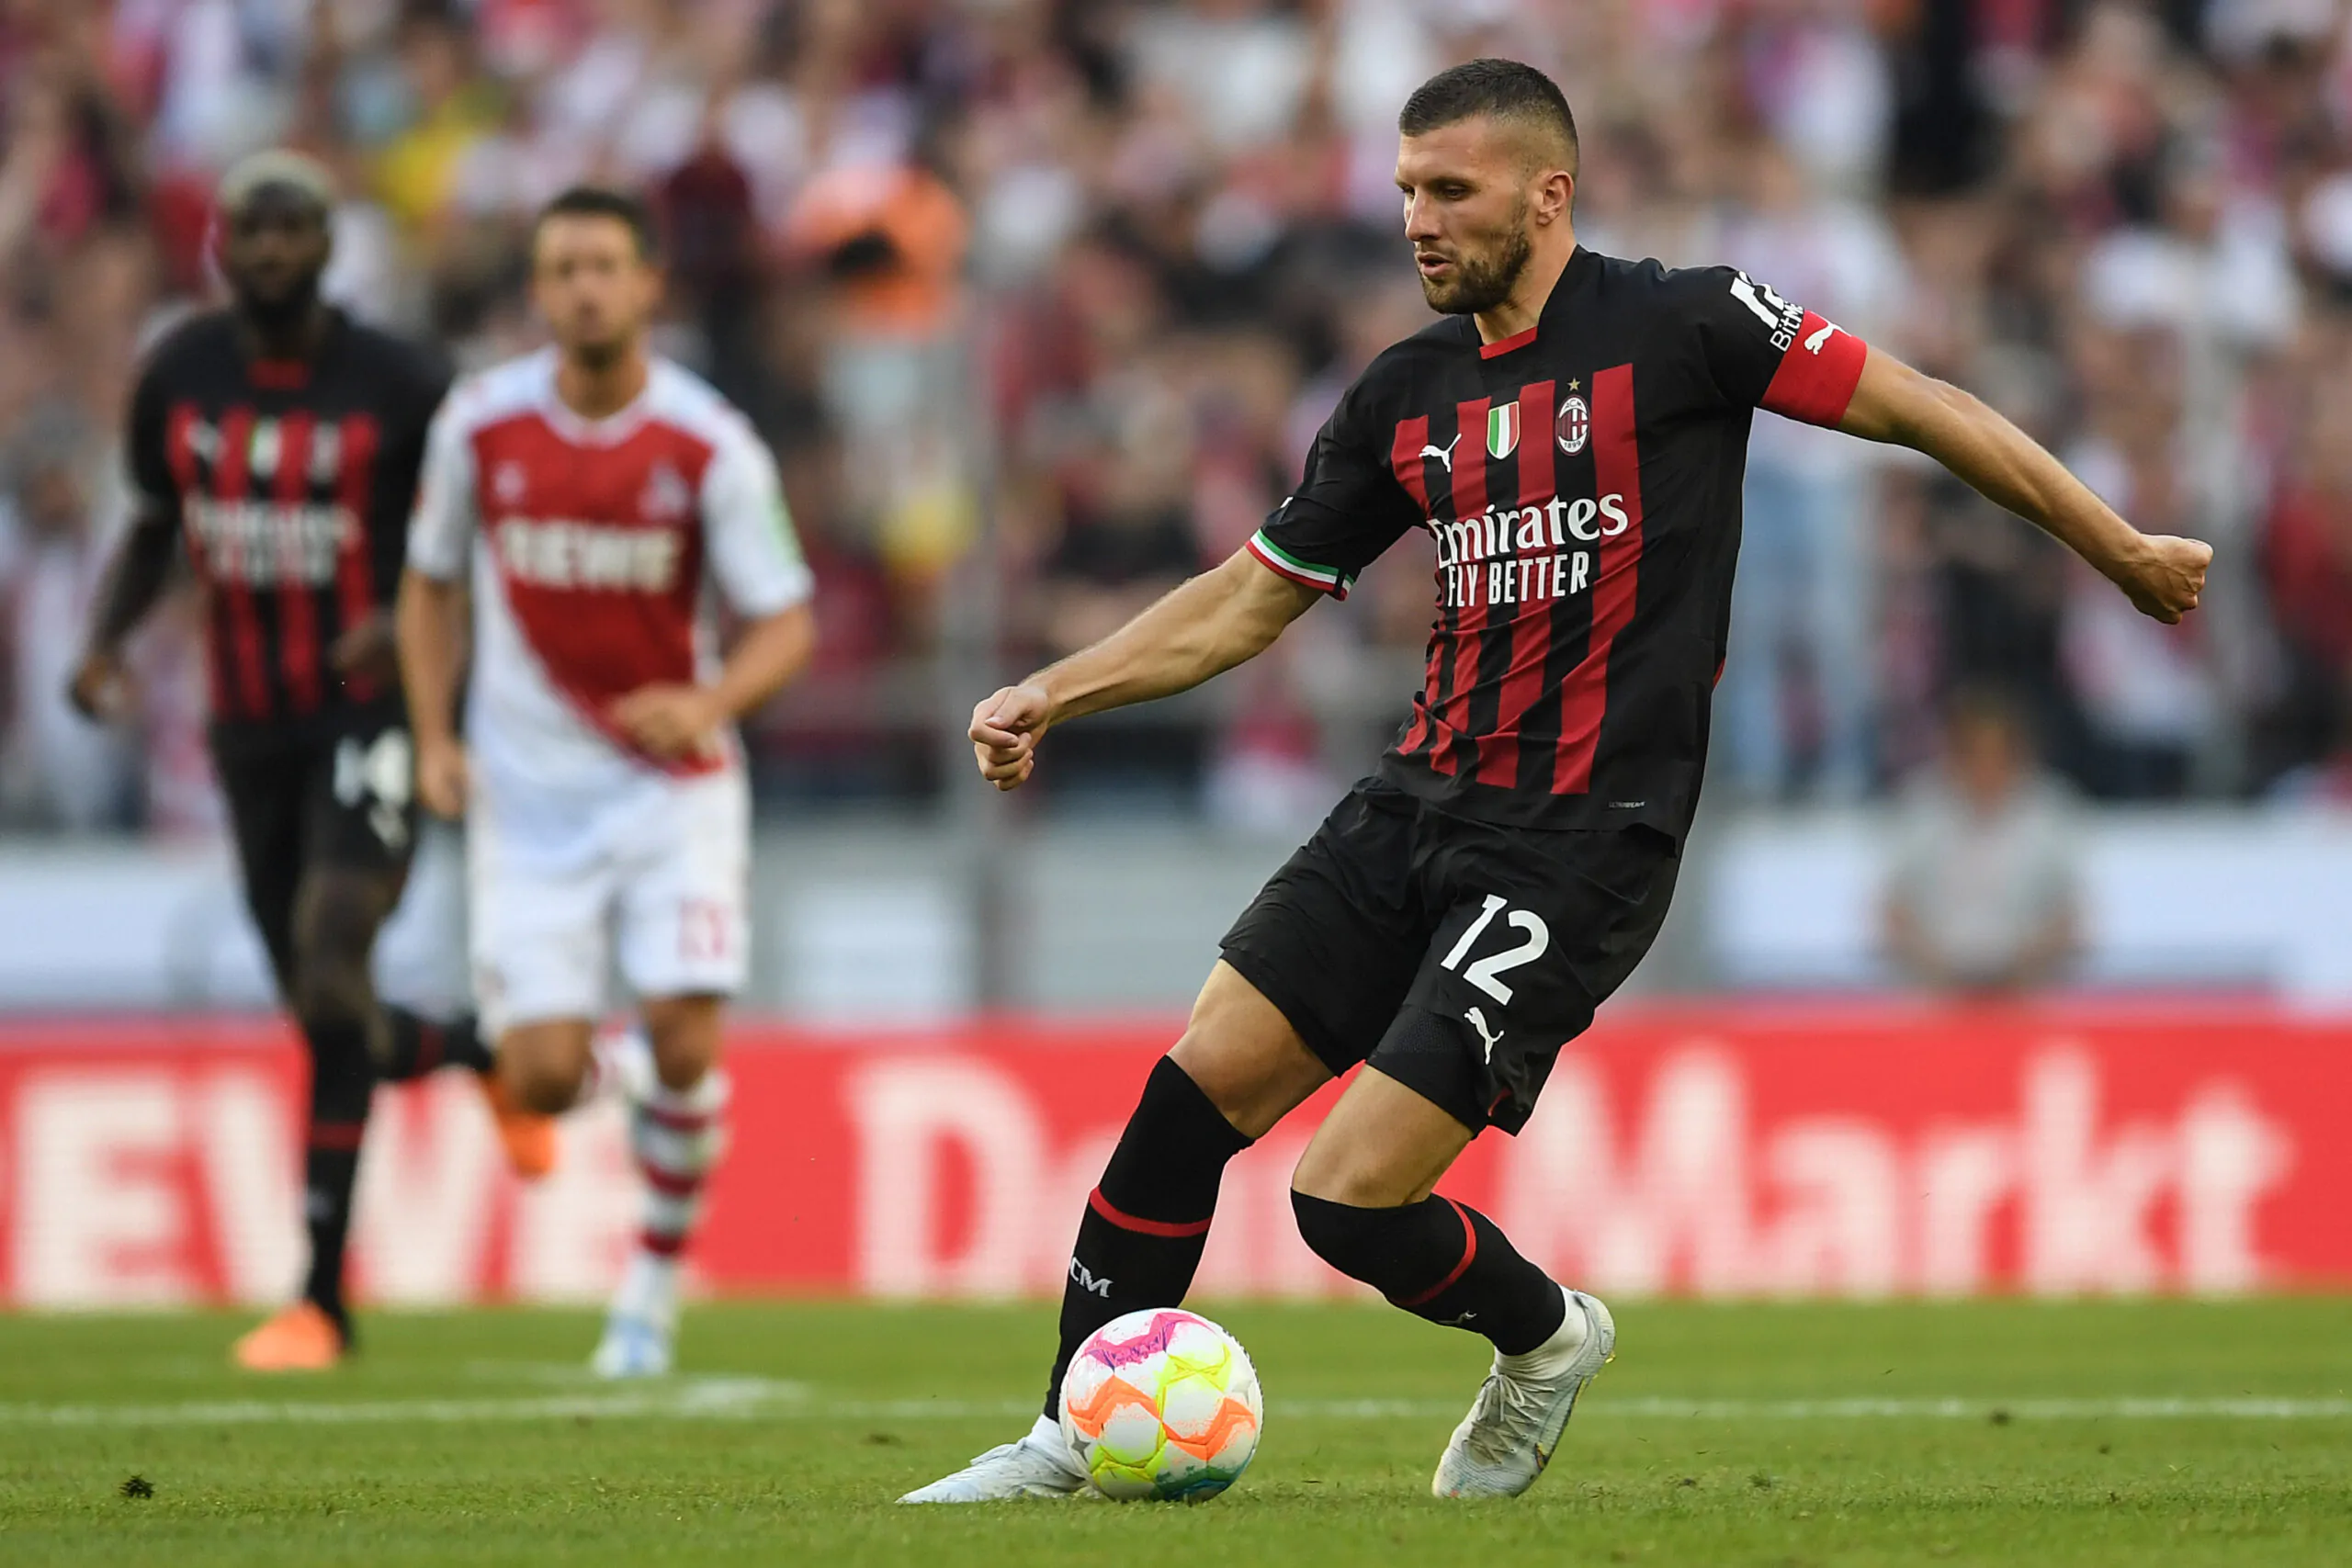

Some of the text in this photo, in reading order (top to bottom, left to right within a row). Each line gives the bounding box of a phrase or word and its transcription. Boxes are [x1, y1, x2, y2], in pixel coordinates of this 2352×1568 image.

[1564, 440, 1582, 449] 1899
[1426, 493, 1628, 569] Emirates
[1447, 551, 1589, 607] FLY BETTER
[1441, 894, 1549, 1006] 12
[1496, 1043, 2288, 1300] Markt
